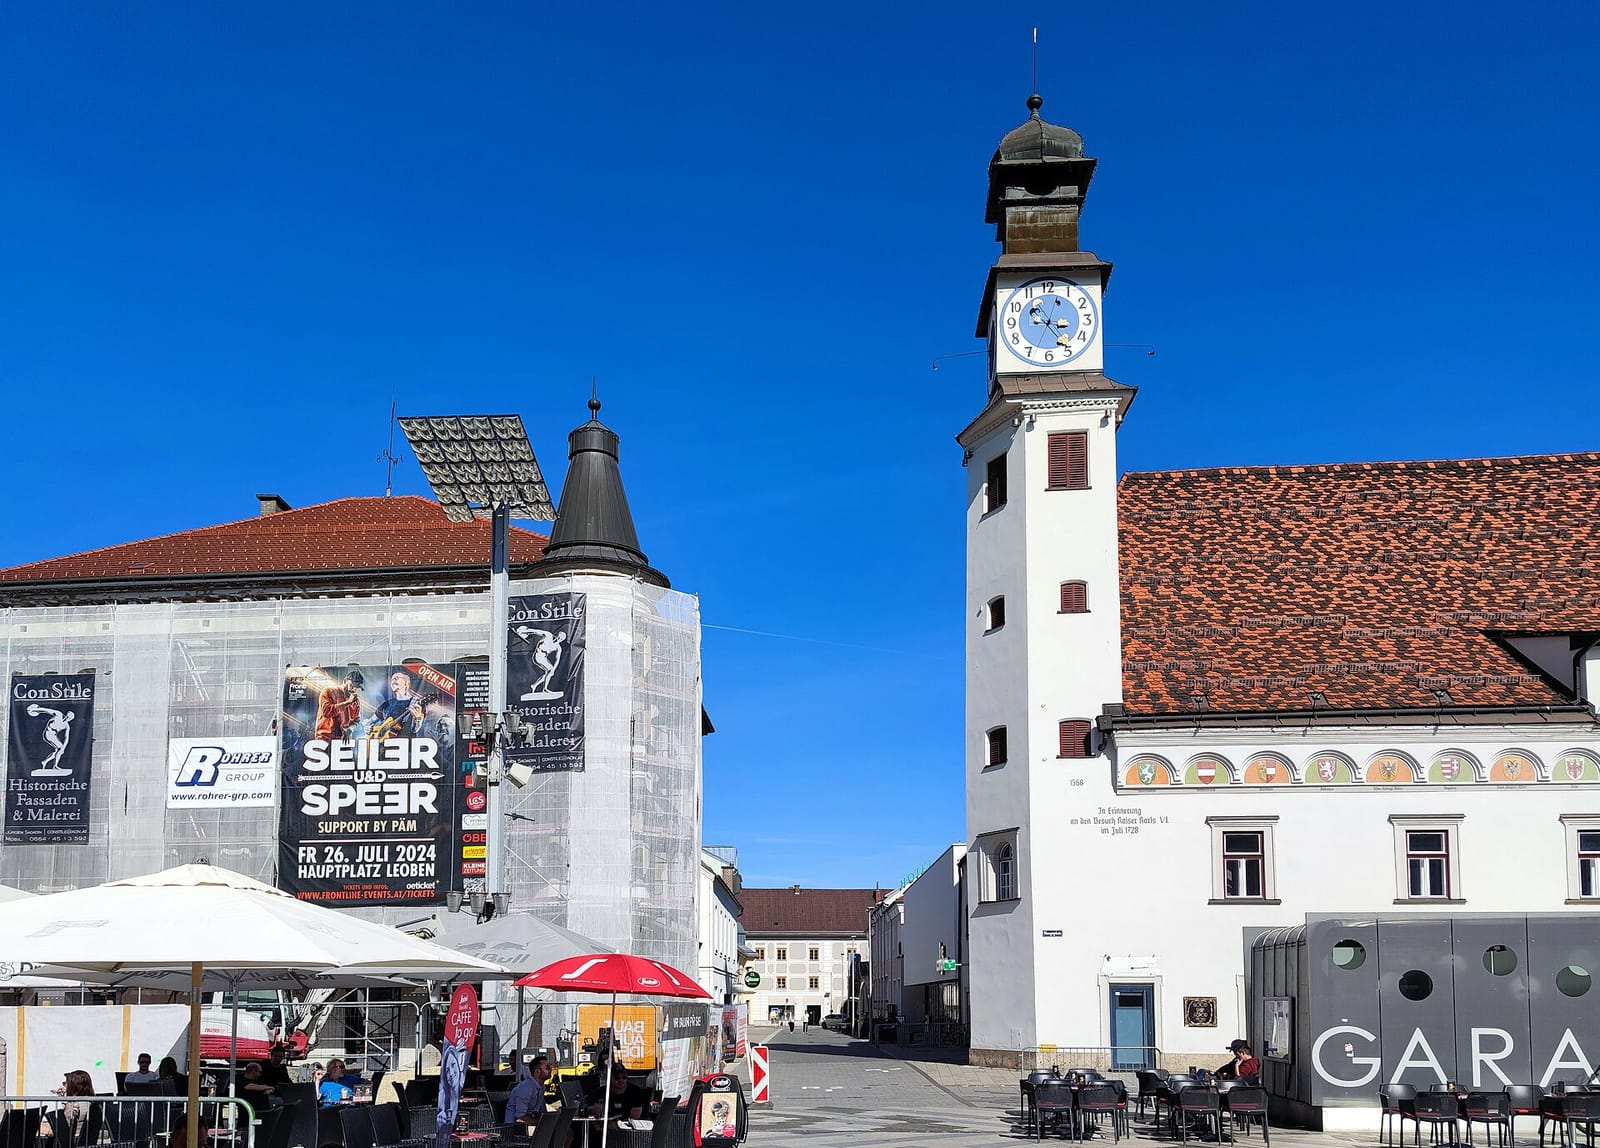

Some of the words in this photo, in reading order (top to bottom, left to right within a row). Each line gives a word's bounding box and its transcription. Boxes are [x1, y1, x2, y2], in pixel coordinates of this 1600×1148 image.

[1025, 288, 1033, 299] 11
[1041, 282, 1054, 293] 12
[1066, 287, 1070, 297] 1
[1011, 302, 1021, 313] 10
[1078, 297, 1087, 309] 2
[1007, 317, 1016, 329] 9
[1083, 314, 1092, 326] 3
[1011, 332, 1020, 345] 8
[1077, 330, 1087, 342] 4
[1025, 347, 1033, 357] 7
[1045, 350, 1054, 361] 6
[1064, 346, 1072, 357] 5
[418, 666, 440, 682] OPEN
[439, 679, 454, 691] AIR
[13, 683, 92, 699] ConStile
[302, 737, 440, 772] SEILER
[175, 746, 272, 786] ROHRER
[225, 773, 265, 782] GROUP
[353, 770, 387, 783] U&D
[9, 778, 88, 791] Historische
[16, 793, 78, 806] Fassaden
[171, 791, 273, 801] www.rohrer-grp.com
[301, 782, 439, 816] SPEER
[13, 809, 23, 821] &
[27, 808, 81, 821] Malerei
[1098, 806, 1106, 814] In
[1108, 806, 1142, 816] Erinnerung
[318, 820, 370, 834] SUPPORT
[373, 820, 388, 832] BY
[391, 818, 417, 832] PÄM
[1080, 817, 1091, 825] den
[1093, 816, 1115, 826] Besuch
[1112, 826, 1123, 835] Juli
[1125, 826, 1139, 834] 1728
[298, 846, 317, 863] FR
[324, 846, 350, 863] 26.
[355, 845, 389, 862] JULI
[396, 844, 437, 862] 2024
[298, 863, 382, 879] HAUPTPLATZ
[386, 862, 435, 877] LEOBEN
[406, 879, 436, 890] oeticket
[297, 889, 435, 900] WWW.FRONTLINE-EVENTS.AT/TICKETS
[451, 1007, 472, 1026] CAFFÈ
[455, 1027, 463, 1038] to
[463, 1027, 473, 1042] go
